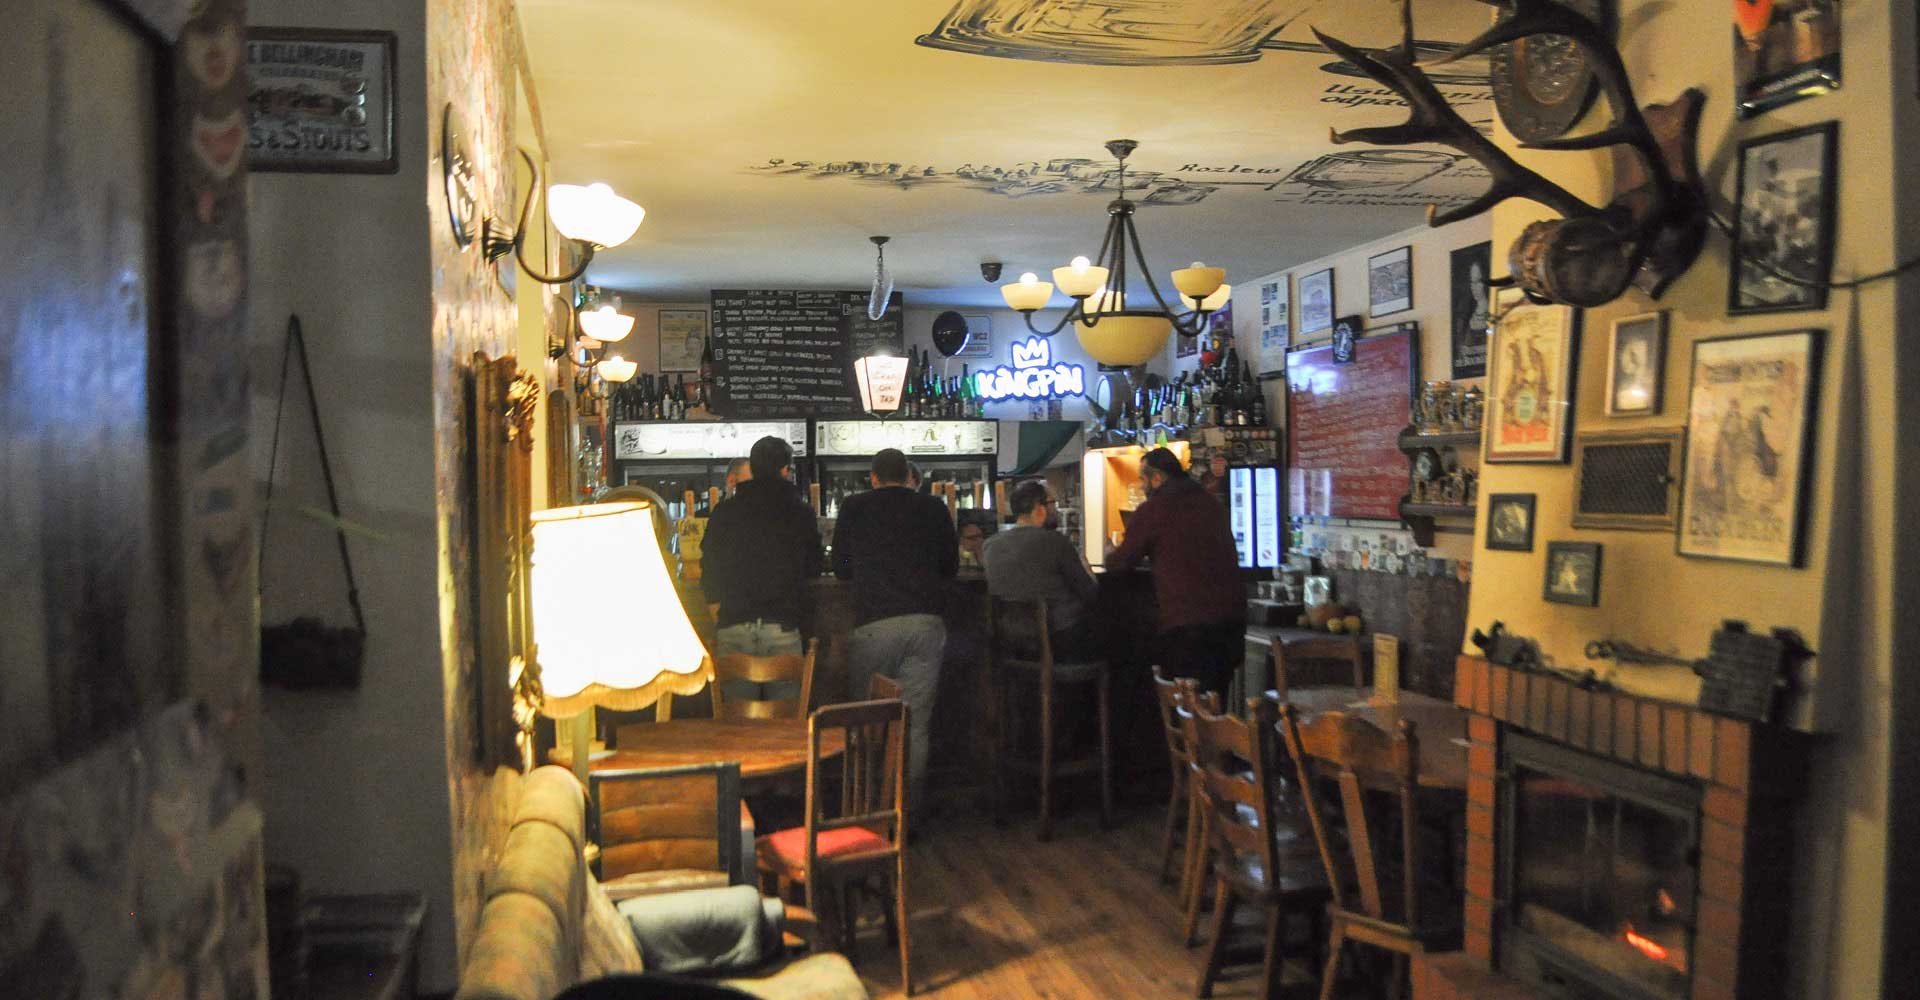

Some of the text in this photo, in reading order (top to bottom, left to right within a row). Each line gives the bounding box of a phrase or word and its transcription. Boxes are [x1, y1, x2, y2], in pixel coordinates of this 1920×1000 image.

[261, 44, 364, 70] BELLINGHAM
[282, 120, 371, 152] STOUTS
[1177, 163, 1281, 174] Rozlew
